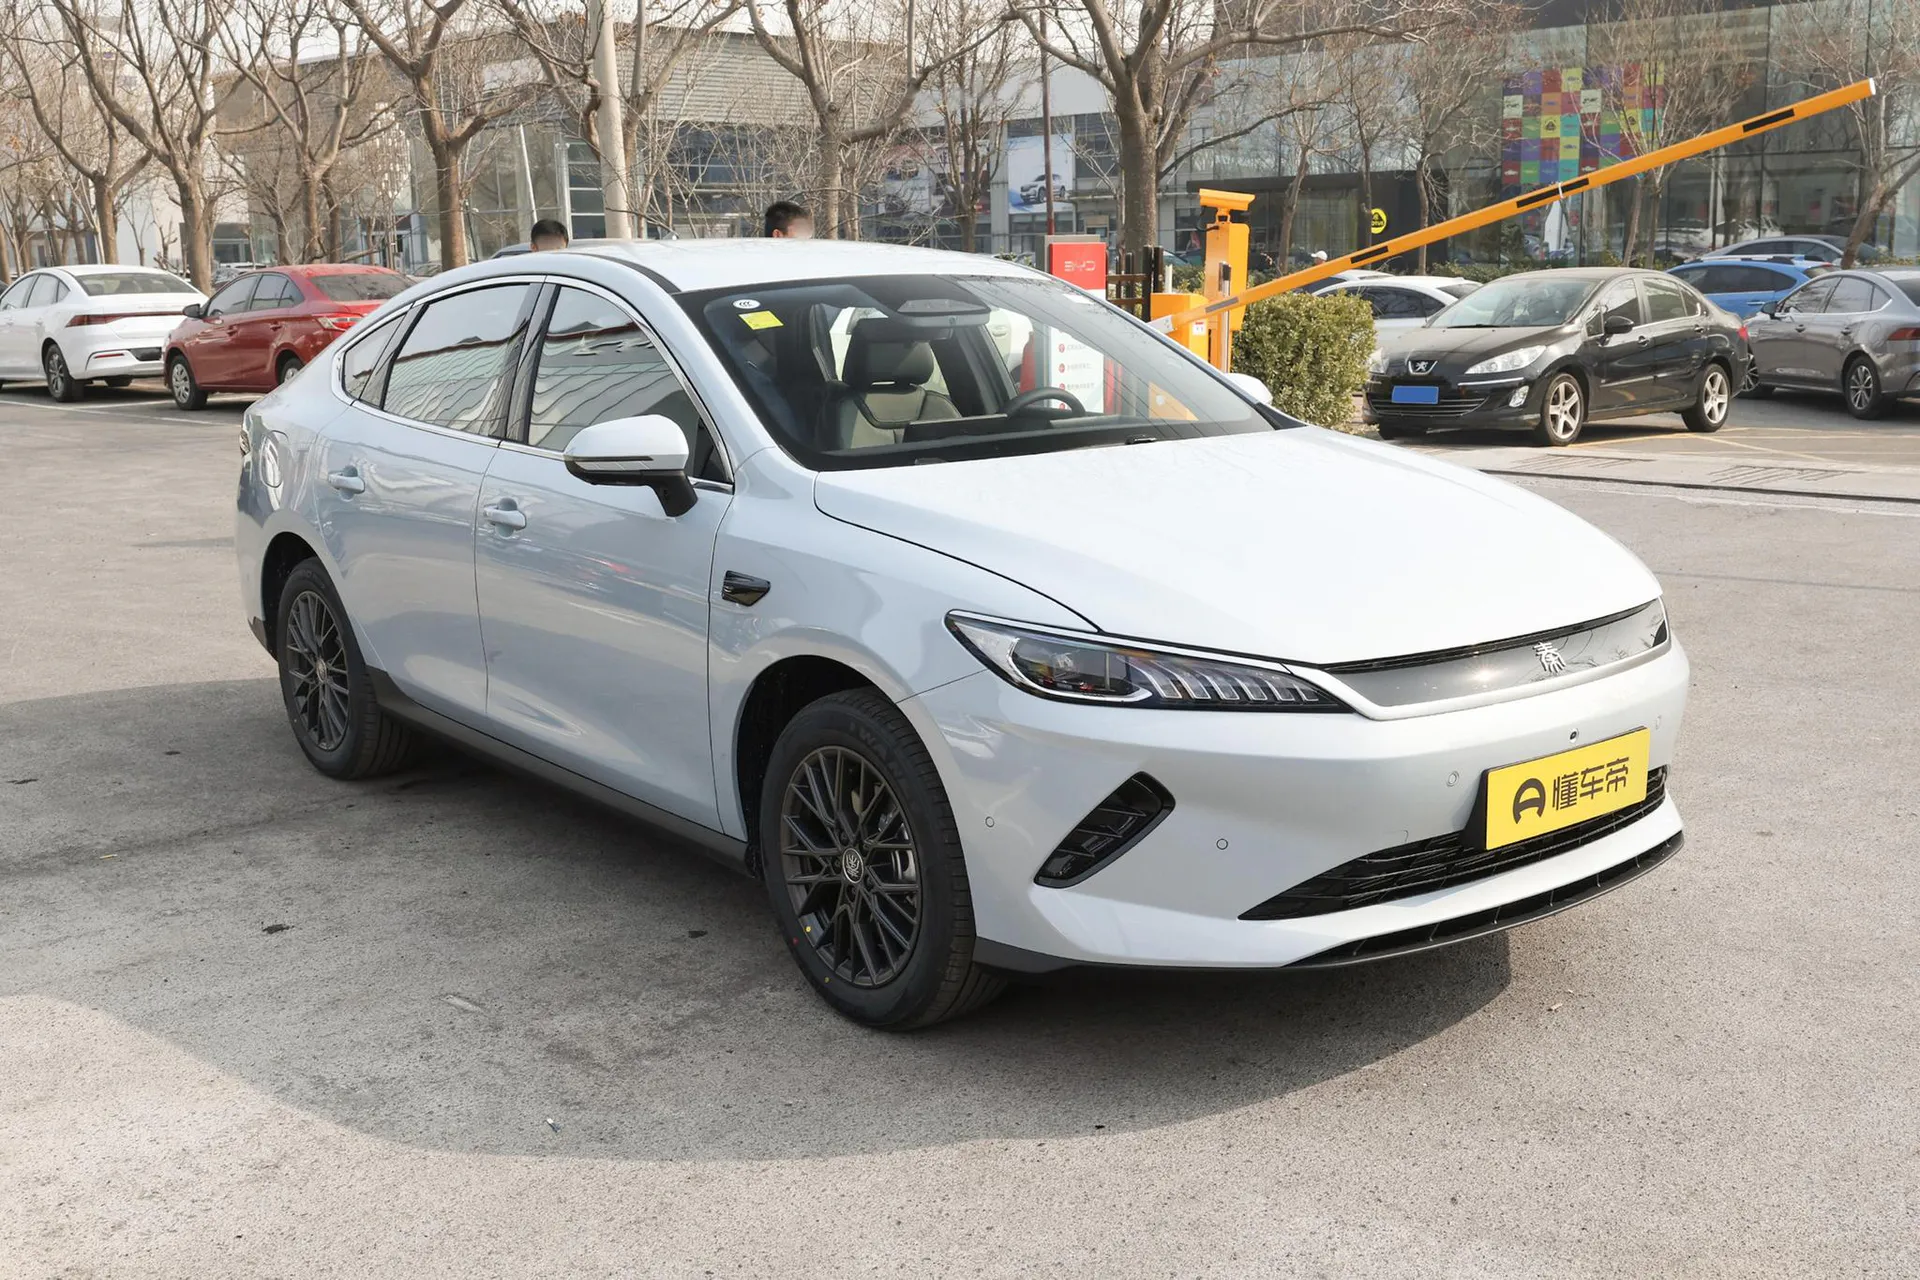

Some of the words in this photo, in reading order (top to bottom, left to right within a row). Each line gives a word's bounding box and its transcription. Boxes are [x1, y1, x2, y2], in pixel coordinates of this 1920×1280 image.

[1064, 260, 1096, 272] BYD
[1532, 640, 1567, 675] 秦
[1552, 756, 1630, 811] 懂车帝
